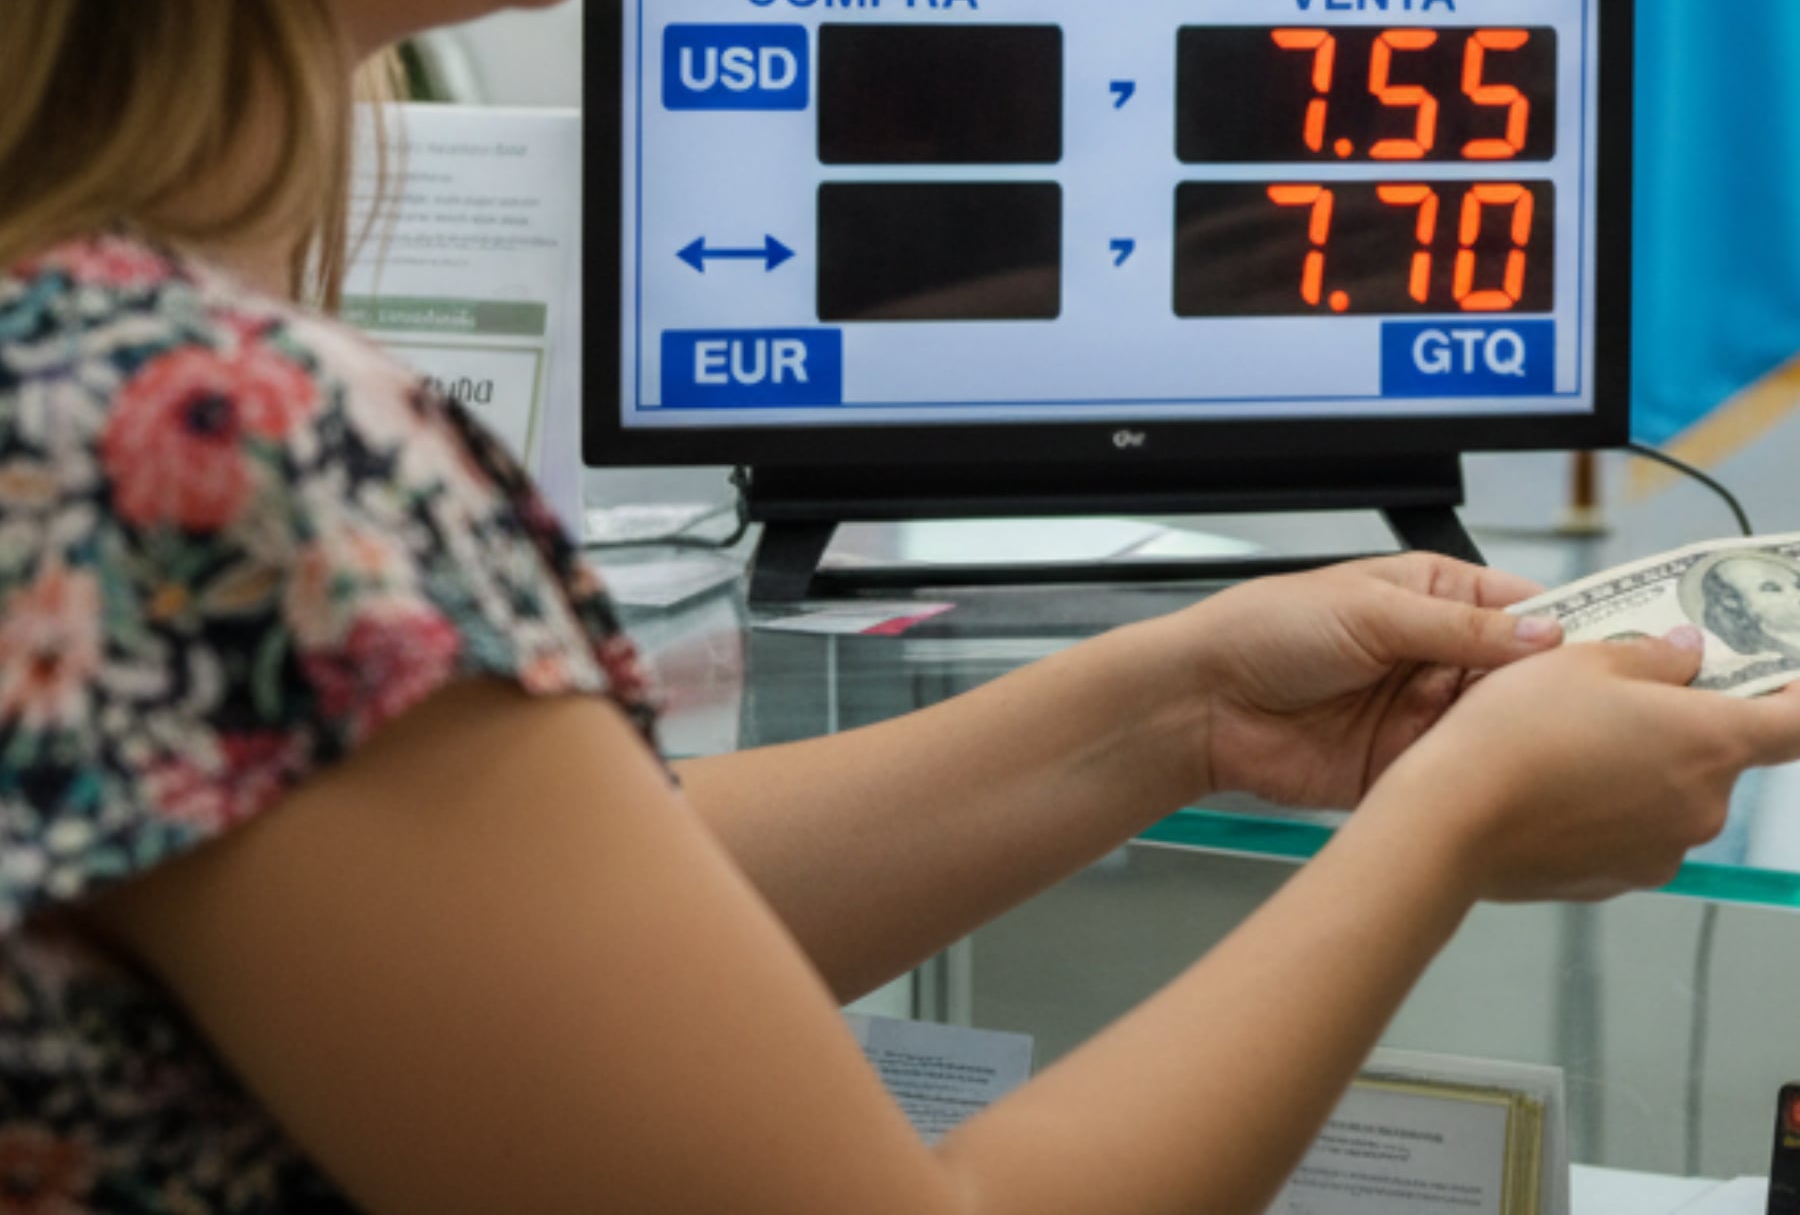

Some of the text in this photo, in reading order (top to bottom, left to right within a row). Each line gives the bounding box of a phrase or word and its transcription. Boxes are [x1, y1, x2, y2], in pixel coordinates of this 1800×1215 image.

[679, 45, 798, 92] USD
[1269, 27, 1532, 161] 7.55
[1265, 181, 1536, 314] 7.70
[693, 339, 807, 384] EUR
[1412, 328, 1526, 377] GTQ
